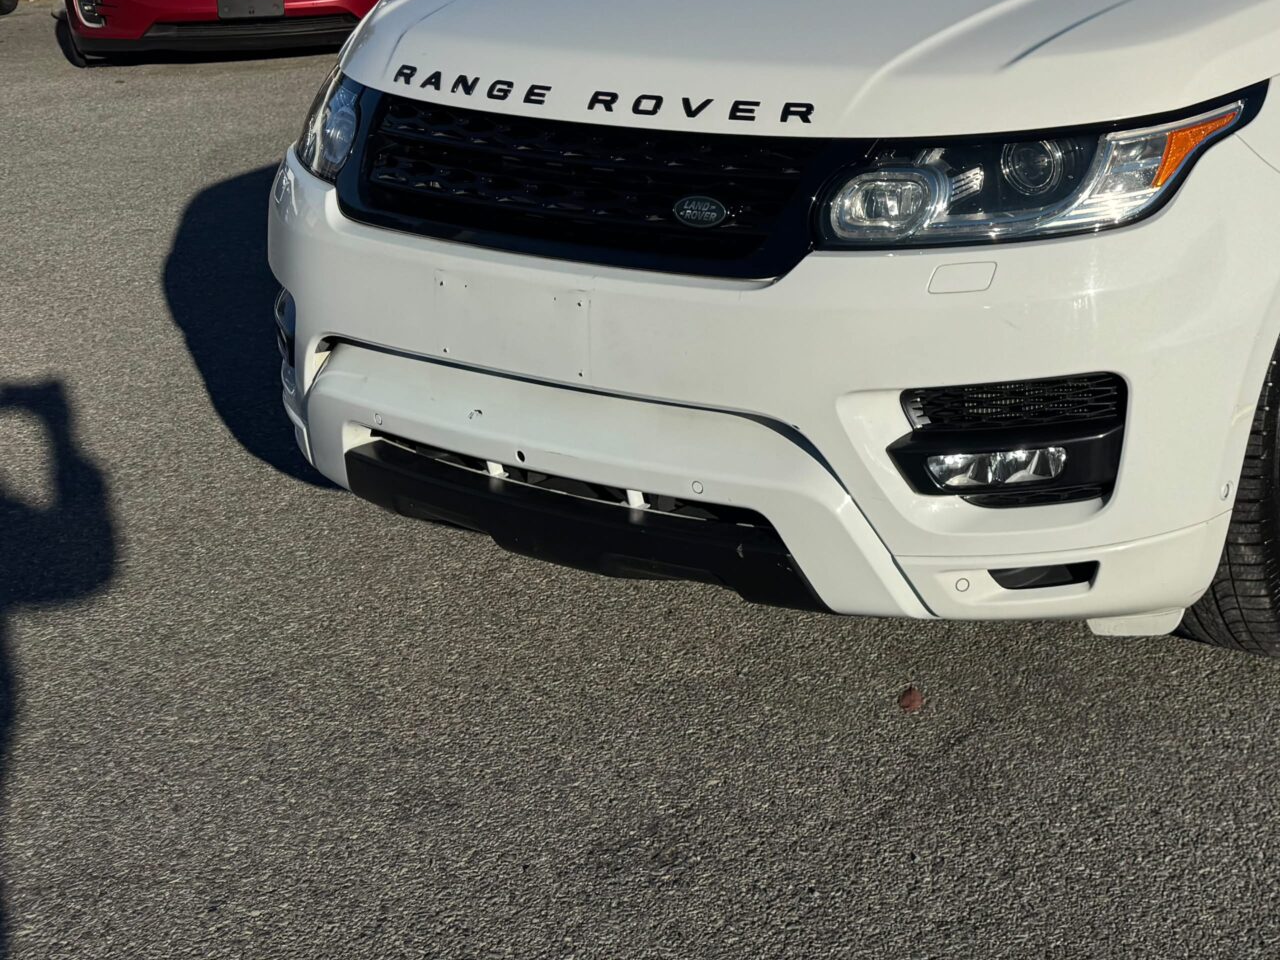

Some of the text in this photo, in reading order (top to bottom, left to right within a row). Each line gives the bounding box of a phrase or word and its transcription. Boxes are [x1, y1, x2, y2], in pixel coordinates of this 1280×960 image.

[392, 64, 815, 124] RANGE ROVER
[684, 209, 717, 222] ROVER
